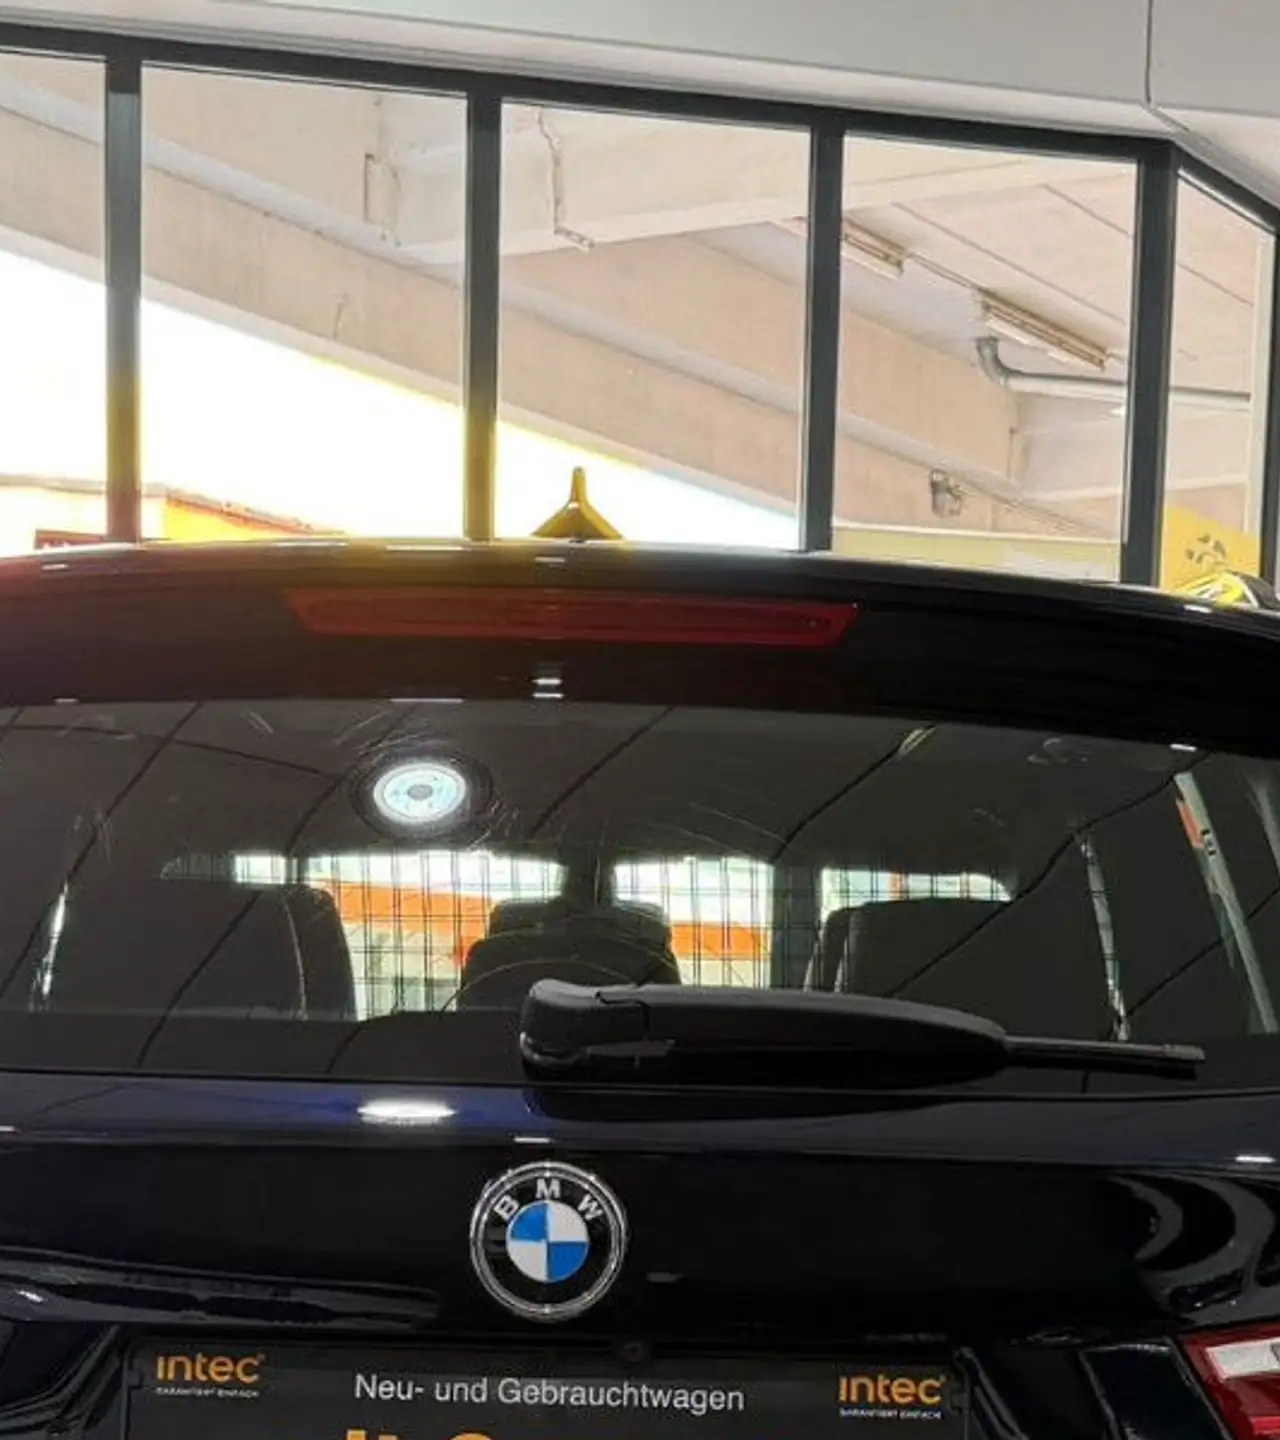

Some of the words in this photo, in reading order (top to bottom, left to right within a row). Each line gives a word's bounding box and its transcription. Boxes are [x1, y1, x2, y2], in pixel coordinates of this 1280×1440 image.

[494, 1178, 604, 1221] BMW
[157, 1352, 260, 1384] intec
[355, 1373, 424, 1400] Neu-
[435, 1378, 488, 1403] und
[498, 1378, 745, 1416] Gebrauchtwagen
[839, 1373, 942, 1405] intec
